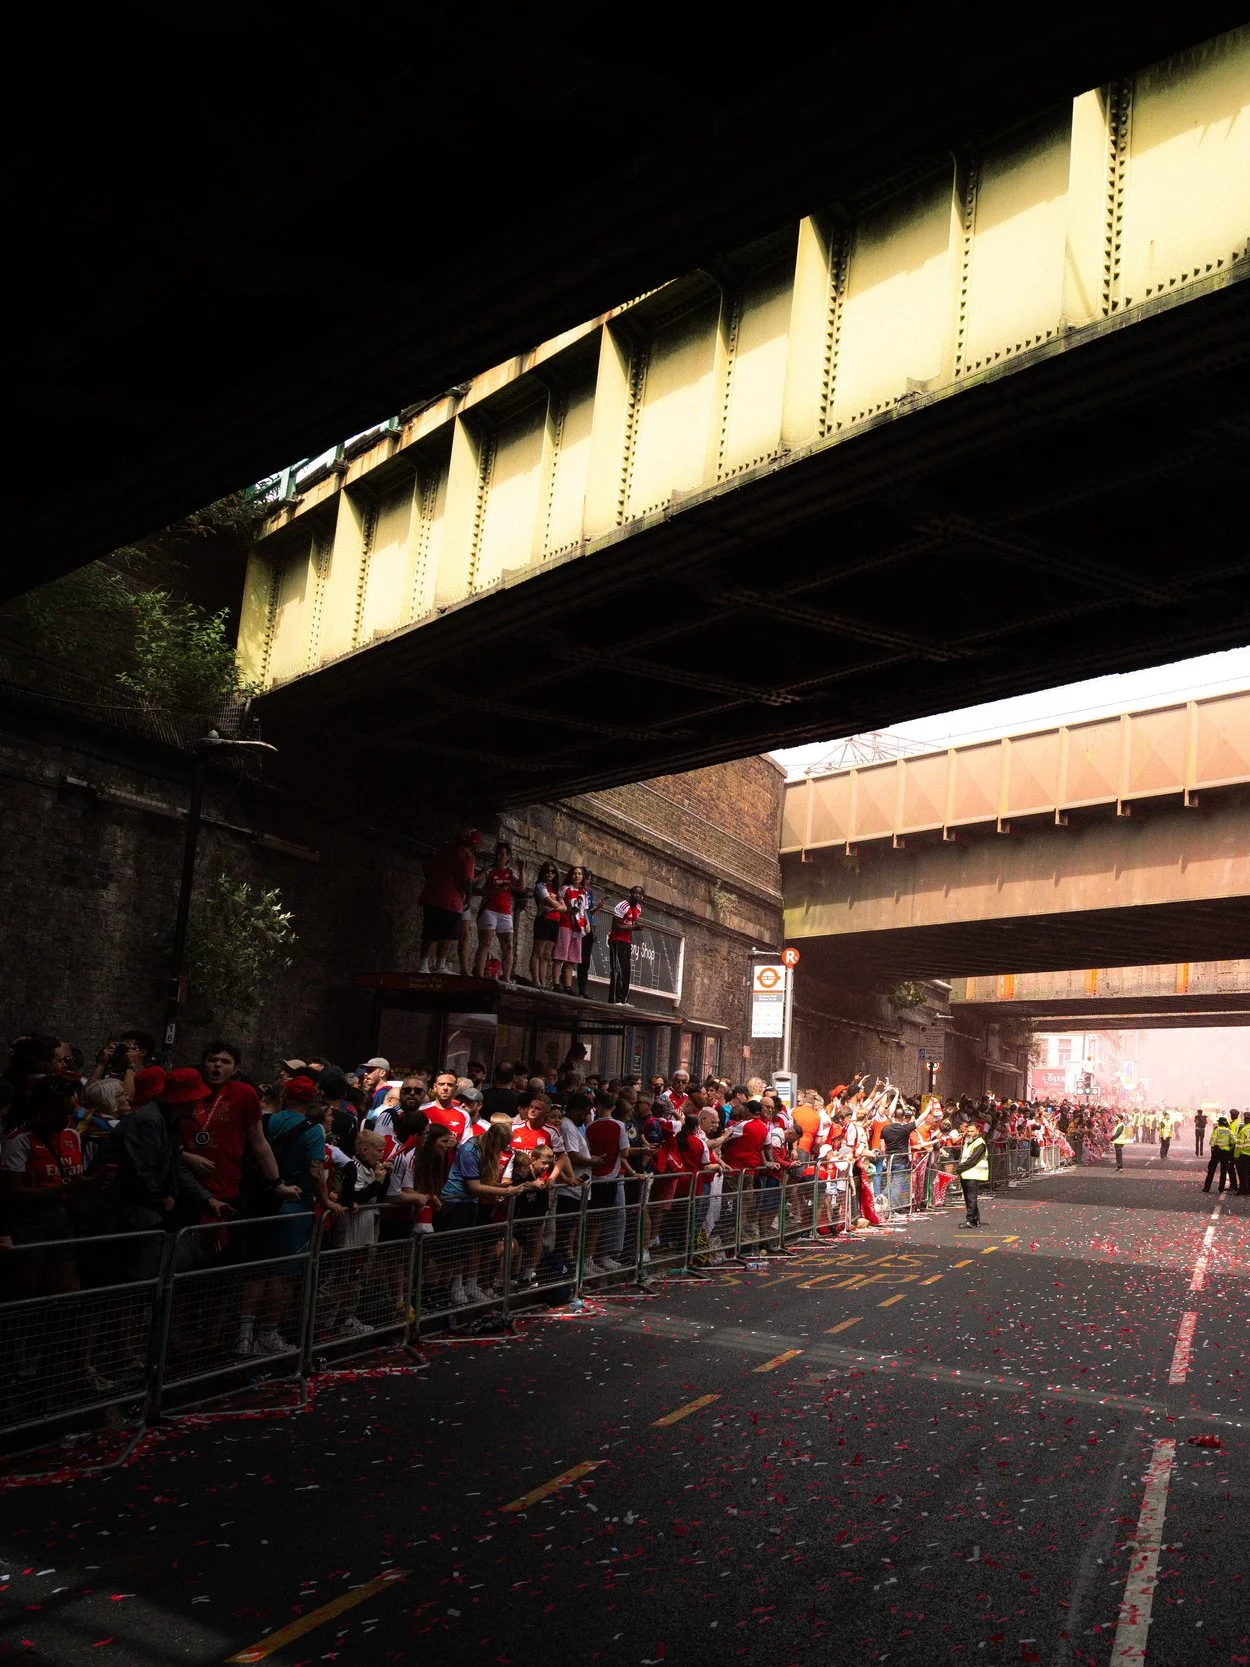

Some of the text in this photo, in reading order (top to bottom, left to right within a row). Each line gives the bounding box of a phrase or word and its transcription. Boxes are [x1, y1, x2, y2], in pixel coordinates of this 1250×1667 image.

[785, 950, 796, 964] R
[786, 1253, 939, 1267] BUS
[690, 1272, 921, 1289] STOP
